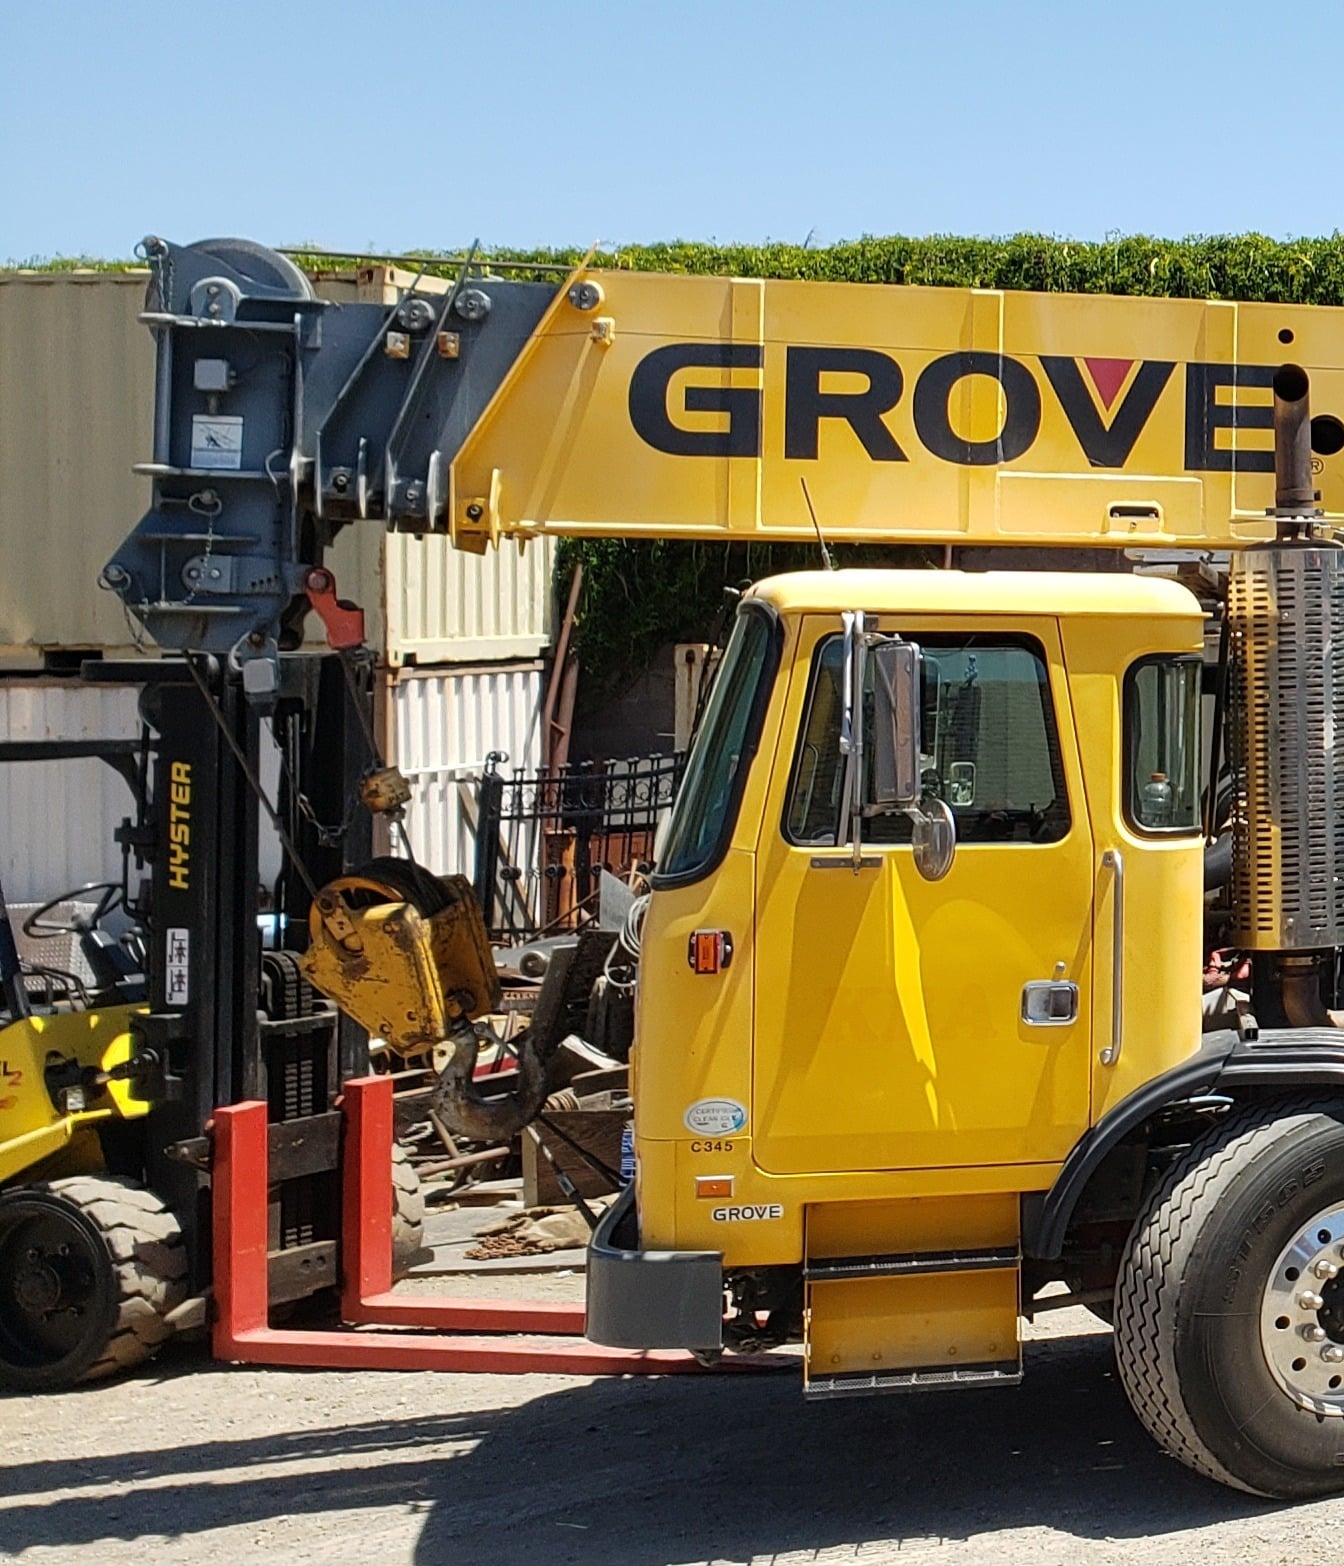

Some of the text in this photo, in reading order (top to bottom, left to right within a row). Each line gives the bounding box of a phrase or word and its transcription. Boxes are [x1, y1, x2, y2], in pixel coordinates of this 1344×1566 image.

[629, 343, 1276, 473] GROVE
[169, 761, 191, 890] HYSTER
[691, 1141, 733, 1152] C345
[713, 1205, 780, 1221] GROVE
